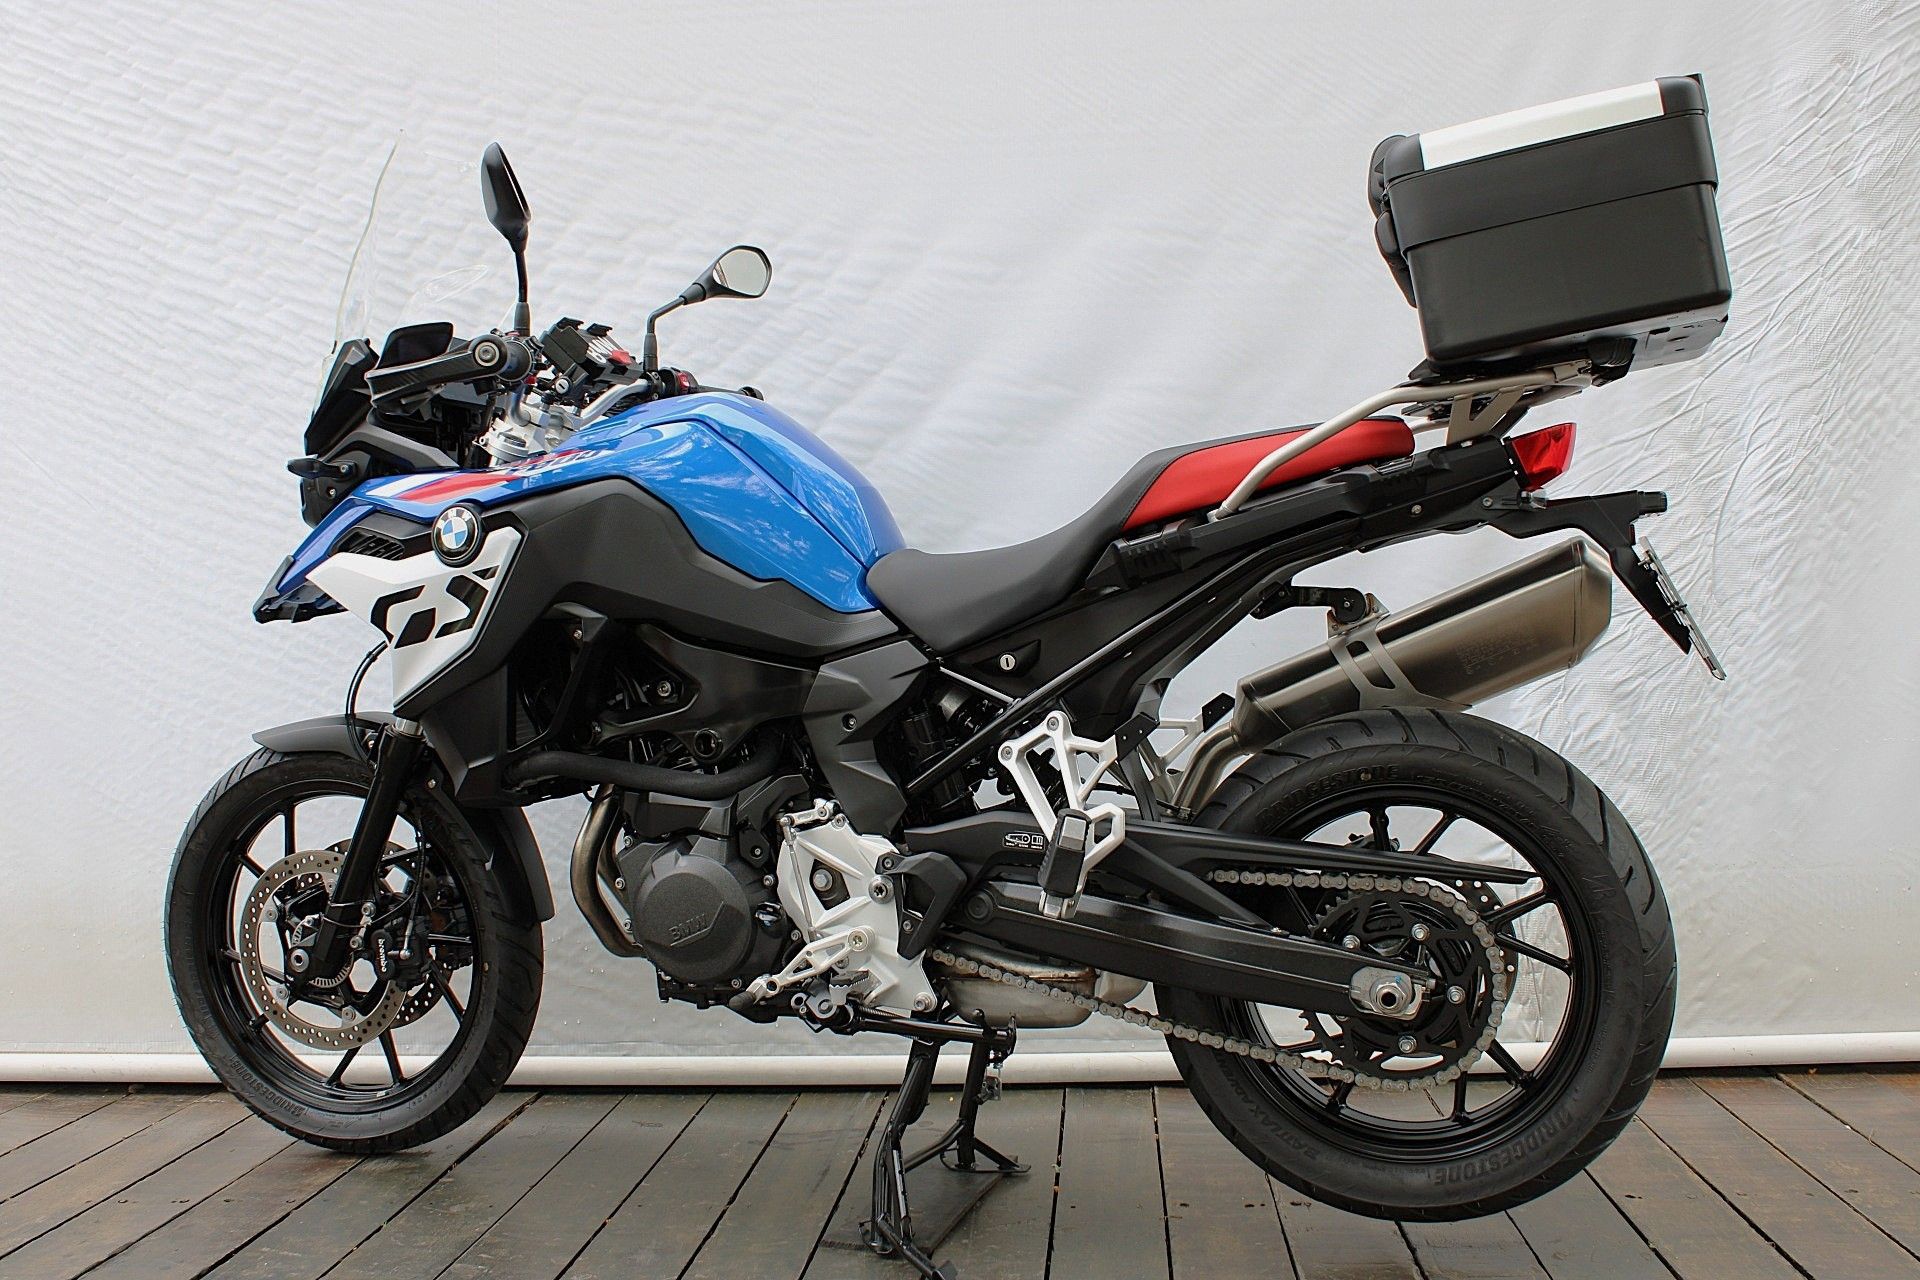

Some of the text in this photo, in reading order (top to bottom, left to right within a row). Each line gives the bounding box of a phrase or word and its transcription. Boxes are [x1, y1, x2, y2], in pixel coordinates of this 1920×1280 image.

[436, 508, 472, 529] BMW
[669, 913, 709, 940] BMW
[378, 938, 388, 973] brembo
[231, 1058, 305, 1118] BRIDGESTONE
[1434, 1109, 1575, 1186] BRIDGESTONE
